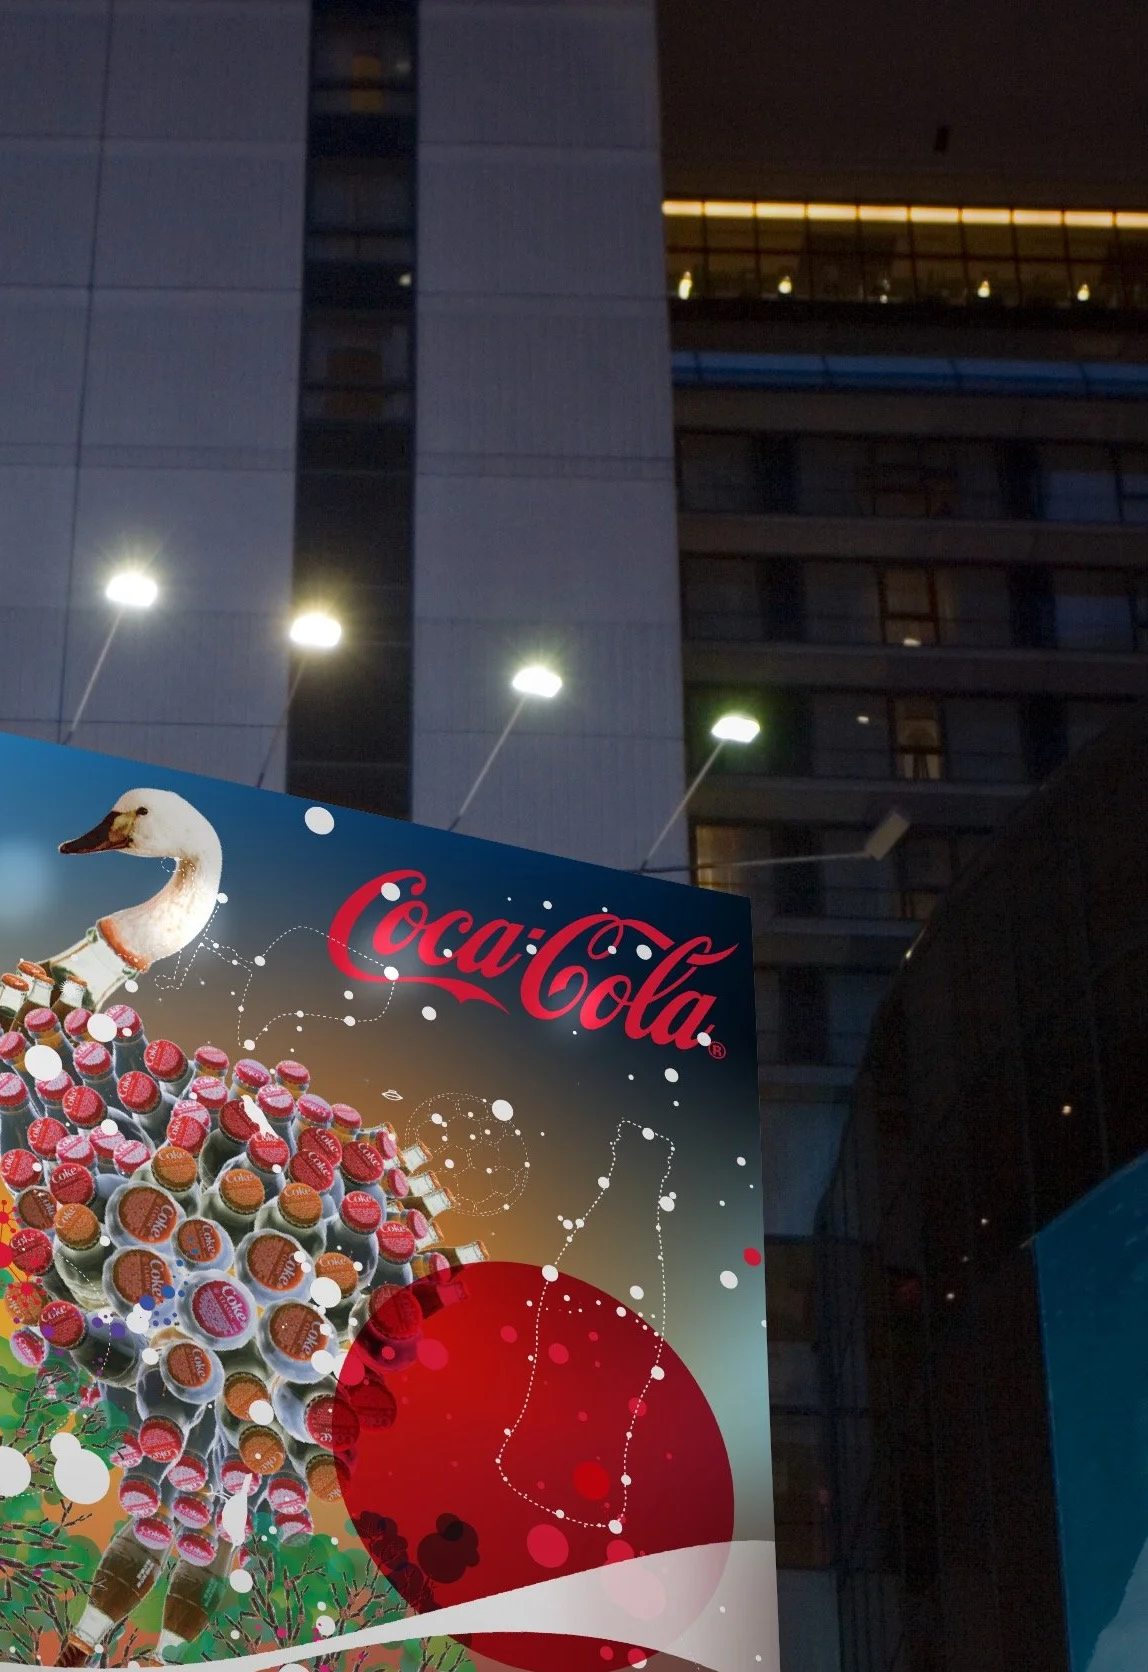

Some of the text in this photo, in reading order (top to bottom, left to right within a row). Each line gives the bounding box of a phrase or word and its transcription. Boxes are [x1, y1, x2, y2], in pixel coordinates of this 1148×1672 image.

[328, 869, 739, 1050] Coca-Cola
[316, 1129, 338, 1152] Coke
[309, 1151, 331, 1175] Coke
[358, 1142, 380, 1166] Coke
[52, 1167, 77, 1184] Coke
[346, 1194, 372, 1203] Coke
[151, 1204, 174, 1237] Coke
[380, 1224, 407, 1233] Coke
[202, 1224, 216, 1252] Coke
[150, 1260, 164, 1297] Coke
[222, 1285, 246, 1322] Coke
